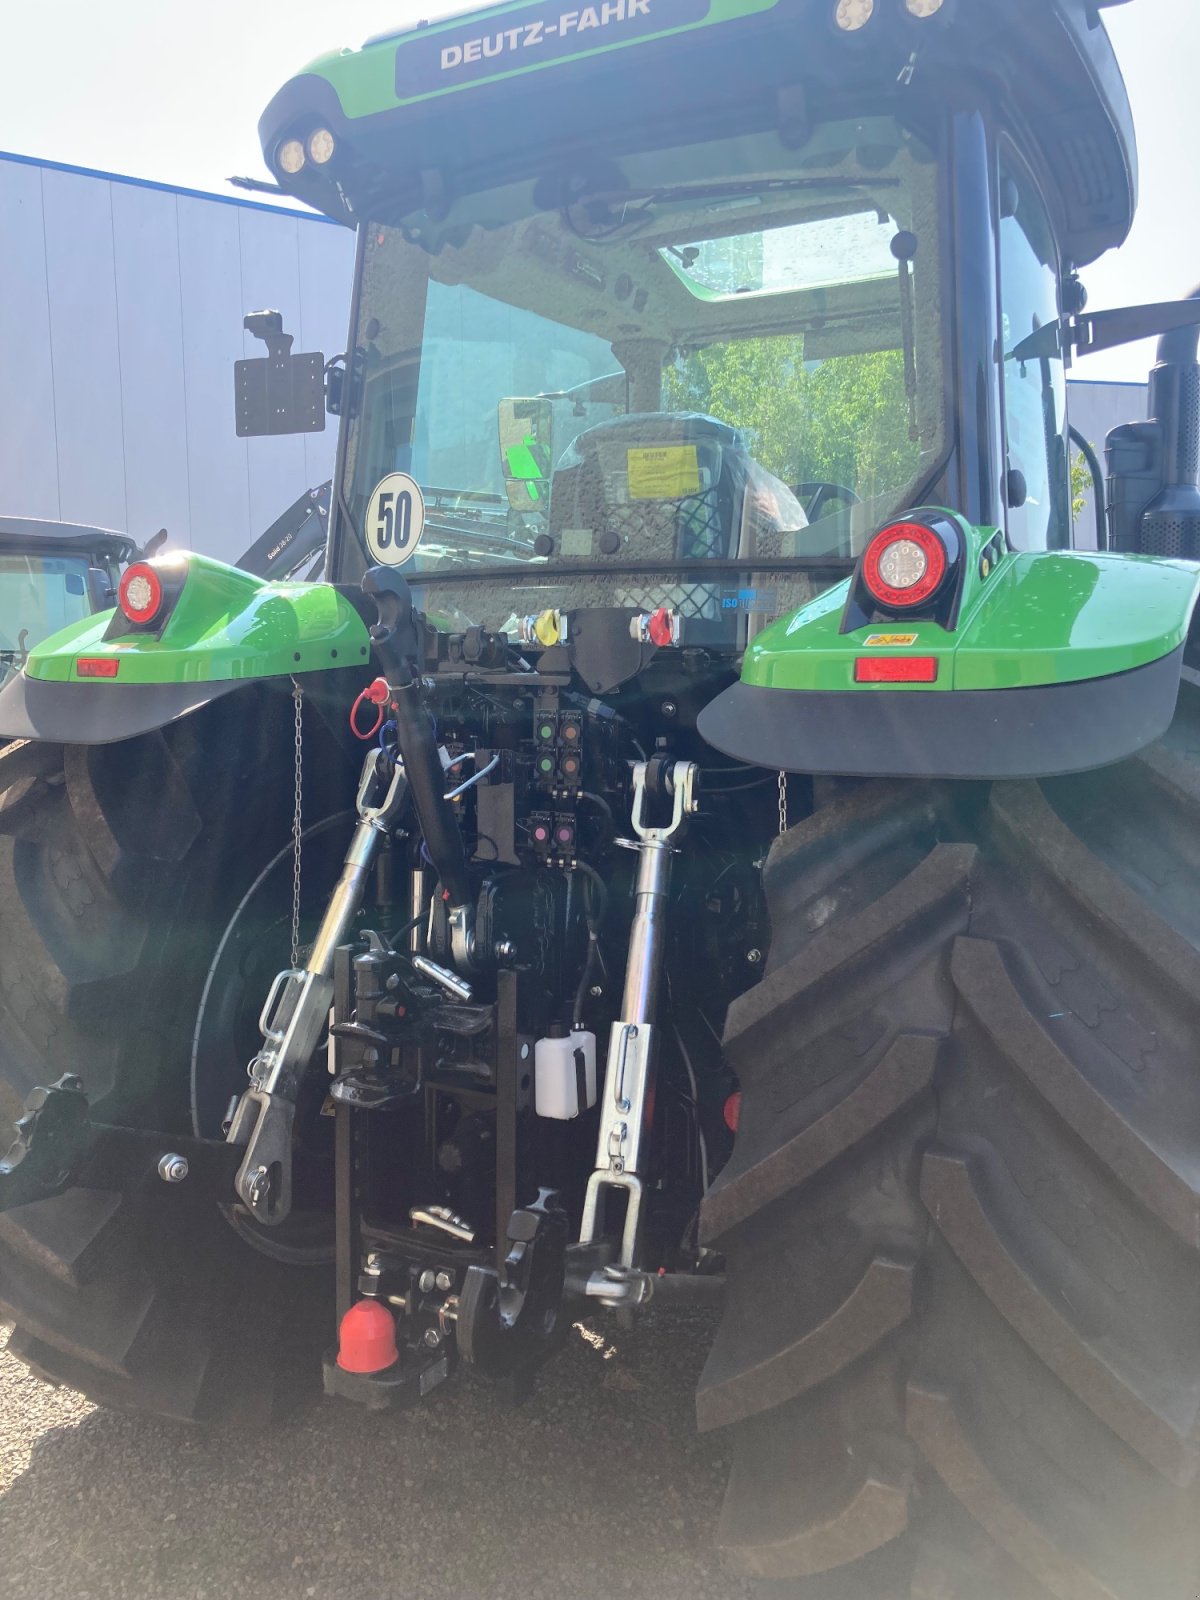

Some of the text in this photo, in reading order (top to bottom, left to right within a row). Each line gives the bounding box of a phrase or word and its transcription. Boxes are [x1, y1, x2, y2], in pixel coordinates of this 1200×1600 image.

[440, 0, 651, 70] DEUTZ-FAHR
[377, 490, 412, 549] 50
[267, 545, 281, 560] Solid
